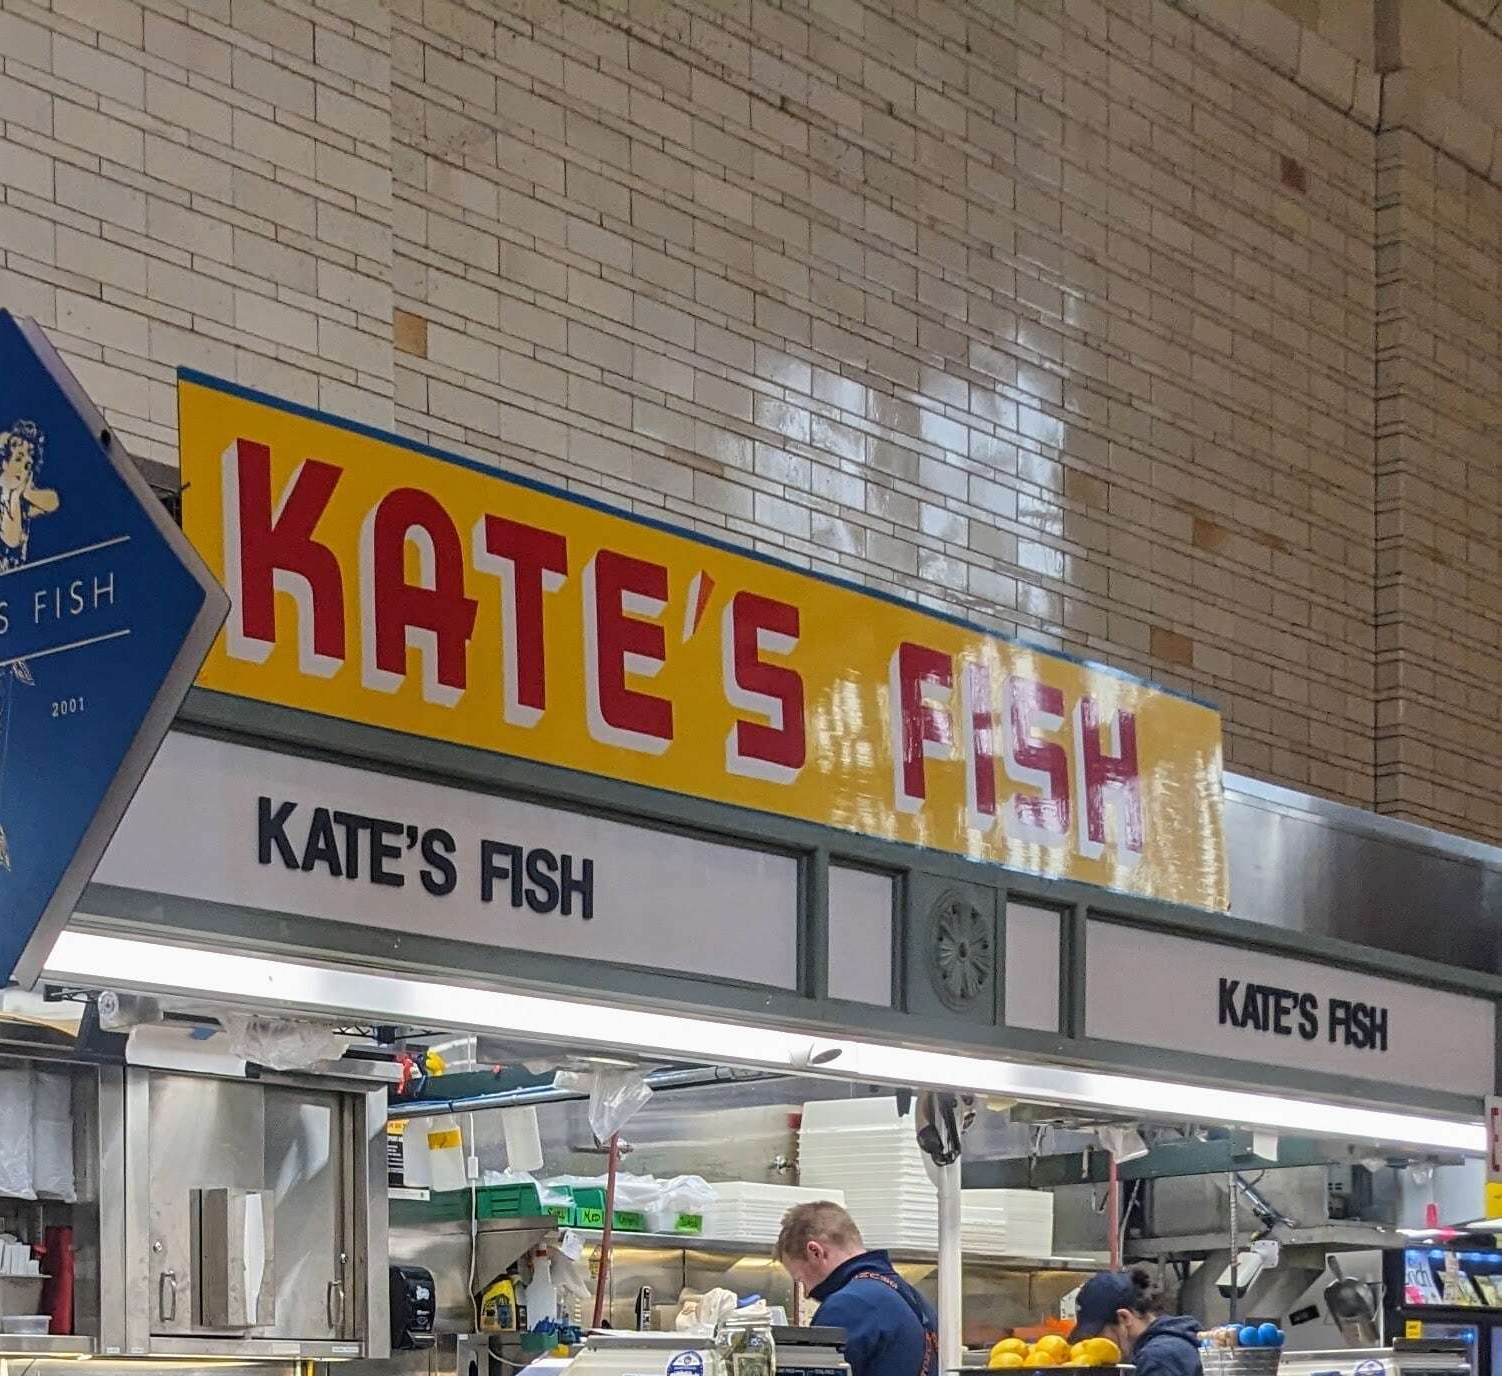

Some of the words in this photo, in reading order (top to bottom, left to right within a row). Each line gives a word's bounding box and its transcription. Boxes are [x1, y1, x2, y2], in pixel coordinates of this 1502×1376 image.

[33, 572, 115, 624] FISH
[222, 437, 806, 785] KATE'S
[890, 641, 1146, 868] FISH
[52, 696, 85, 717] 2001
[257, 796, 458, 896] KATE'S
[481, 839, 594, 919] FISH
[1219, 977, 1319, 1041] KATE'S
[1329, 999, 1388, 1051] FISH
